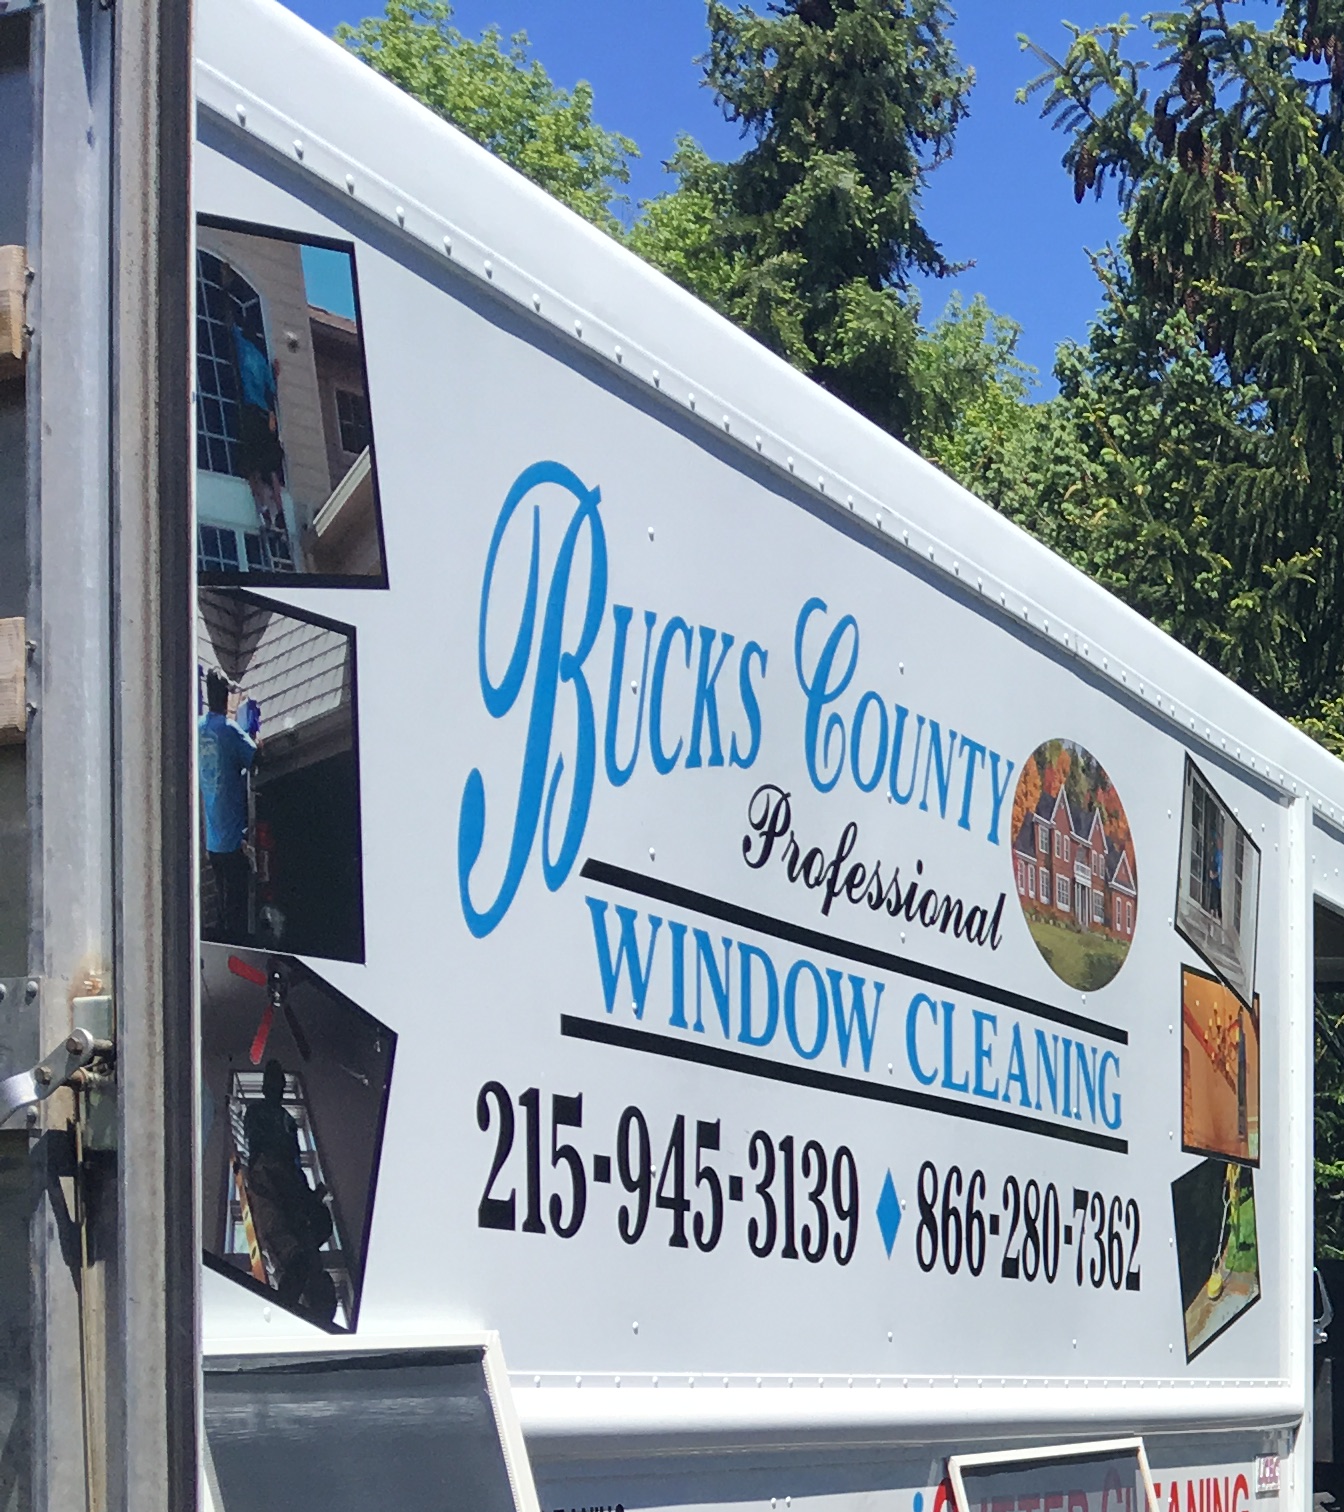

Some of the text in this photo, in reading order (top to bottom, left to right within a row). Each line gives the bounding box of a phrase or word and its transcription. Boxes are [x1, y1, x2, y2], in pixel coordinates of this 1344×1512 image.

[742, 784, 1007, 951] Professional
[585, 896, 1123, 1132] WINDOW CLEANING
[476, 1080, 1142, 1292] 215-945-3139 866-280-7362
